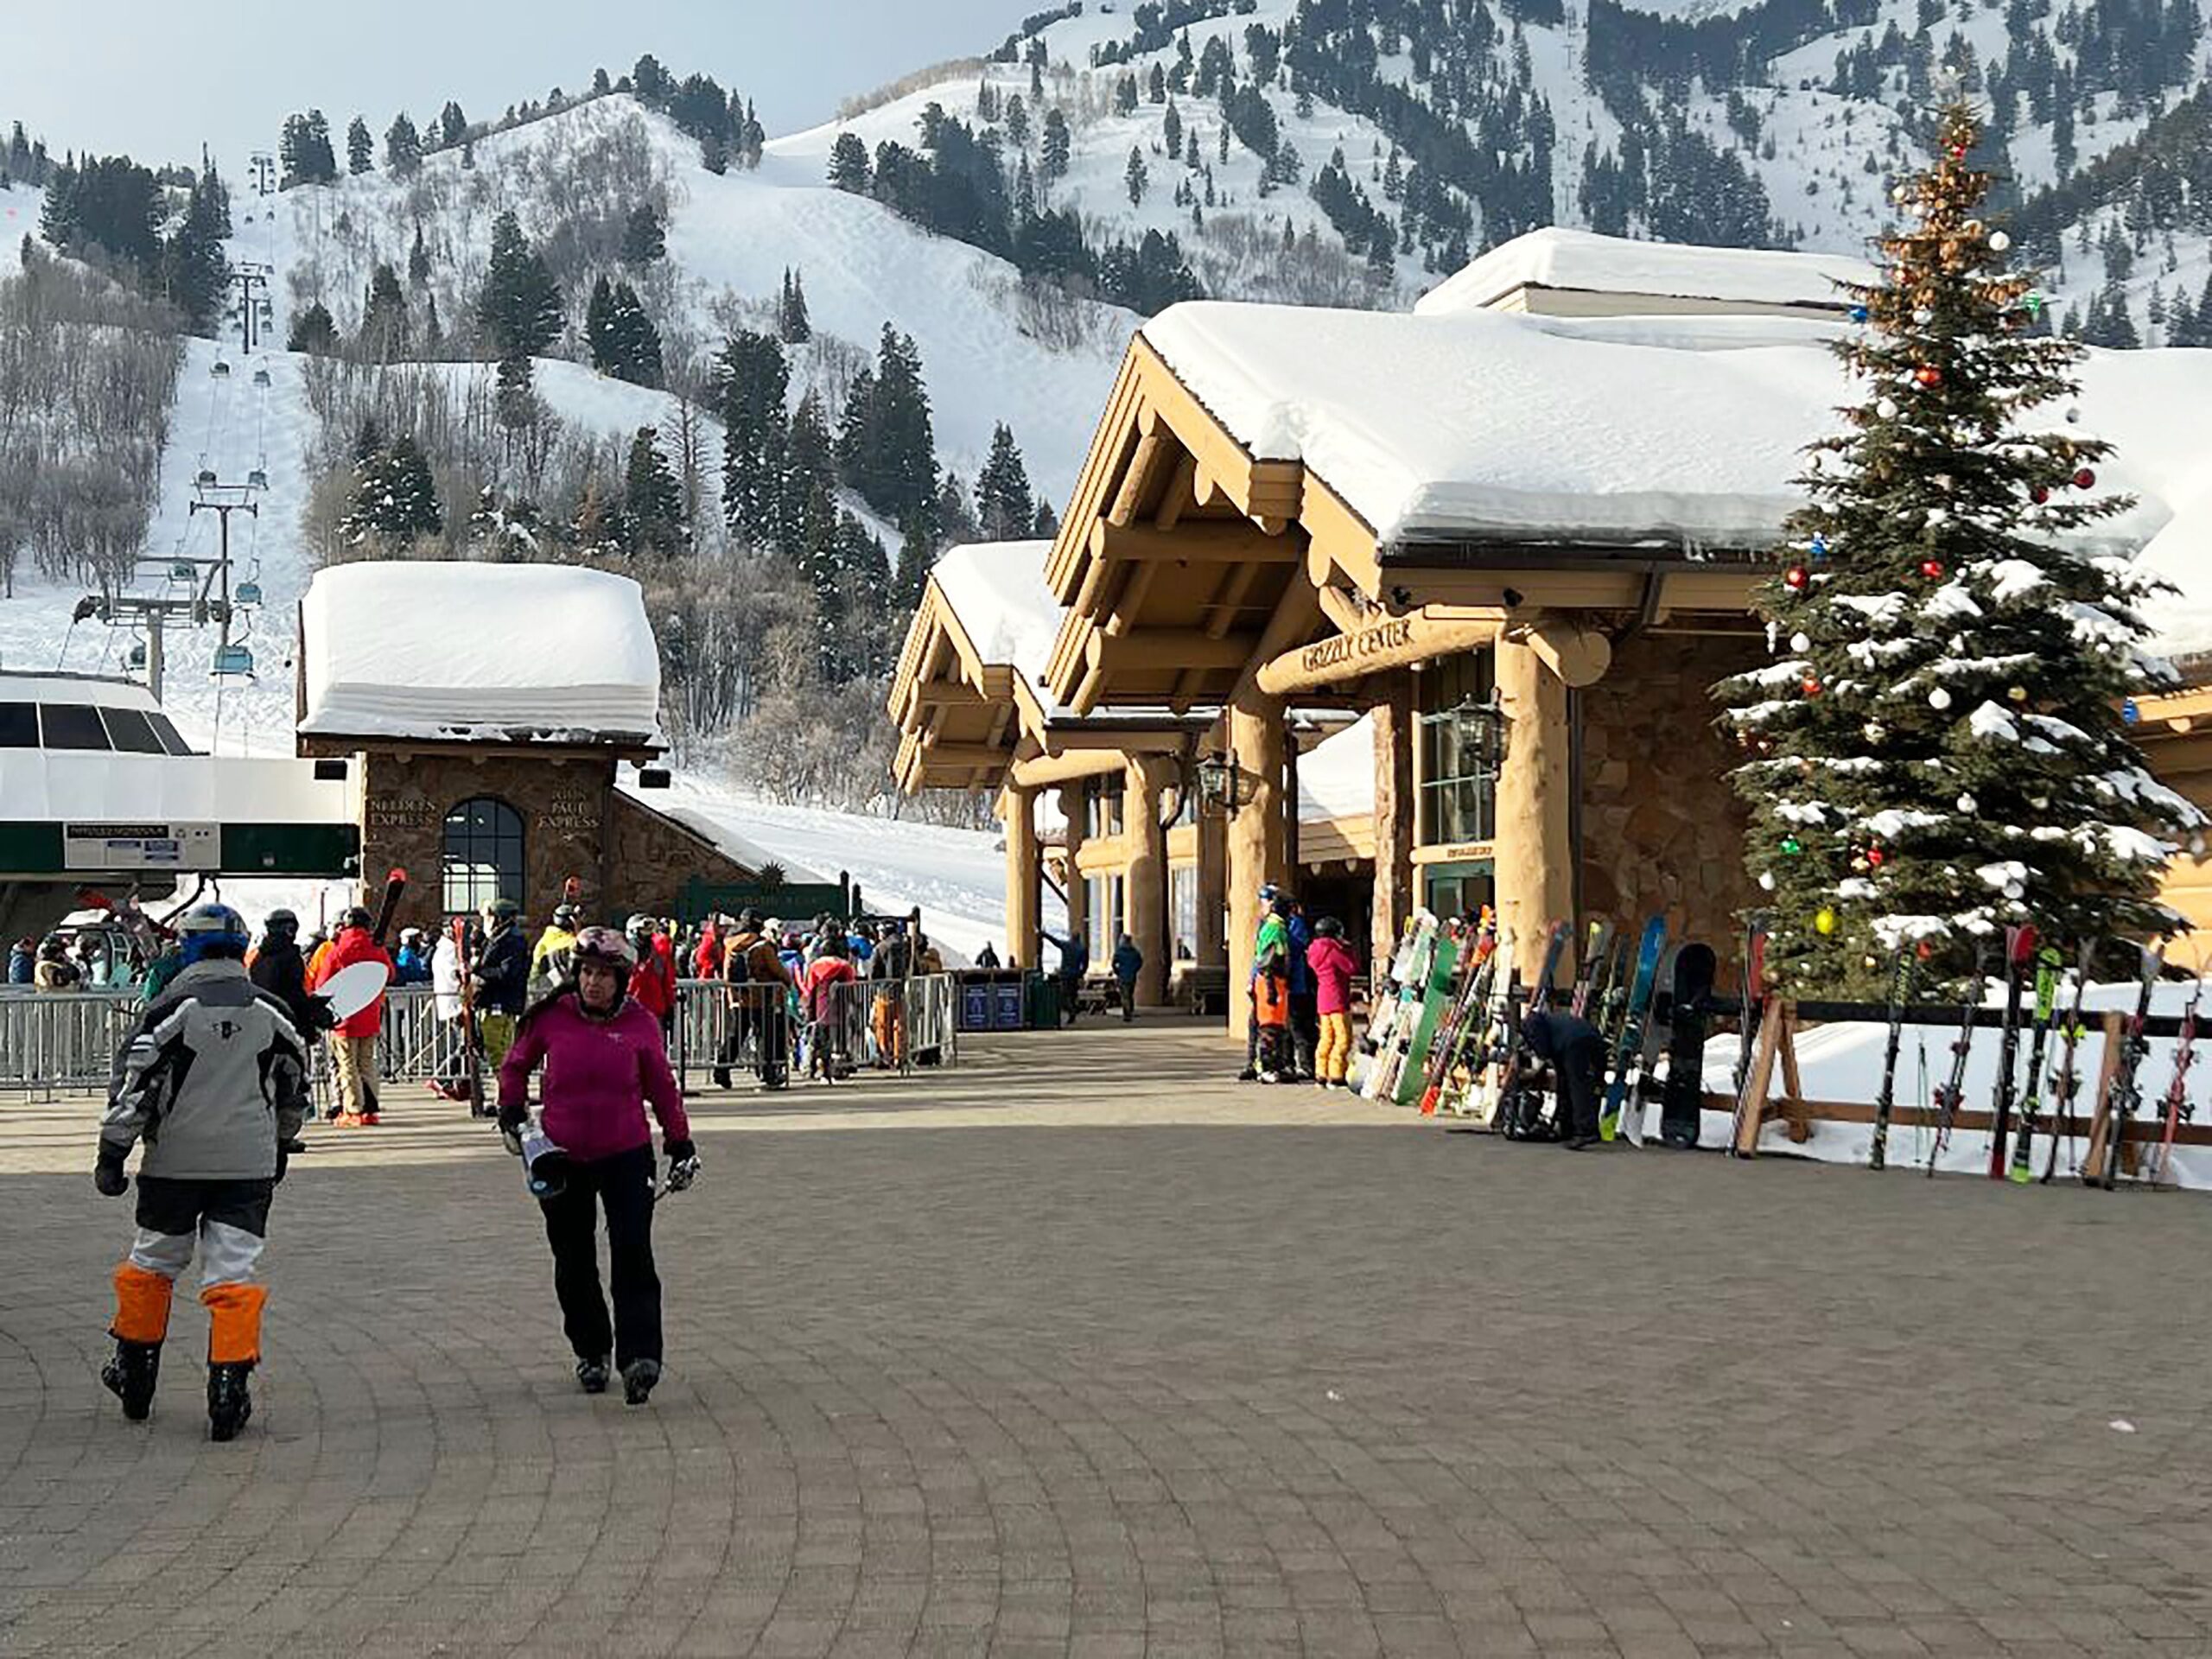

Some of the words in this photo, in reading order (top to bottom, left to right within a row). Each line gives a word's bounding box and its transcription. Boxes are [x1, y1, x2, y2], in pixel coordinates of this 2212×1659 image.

[1302, 633, 1354, 672] GRIZZLY
[1358, 618, 1414, 657] CENTER
[537, 816, 600, 828] EXPRESS
